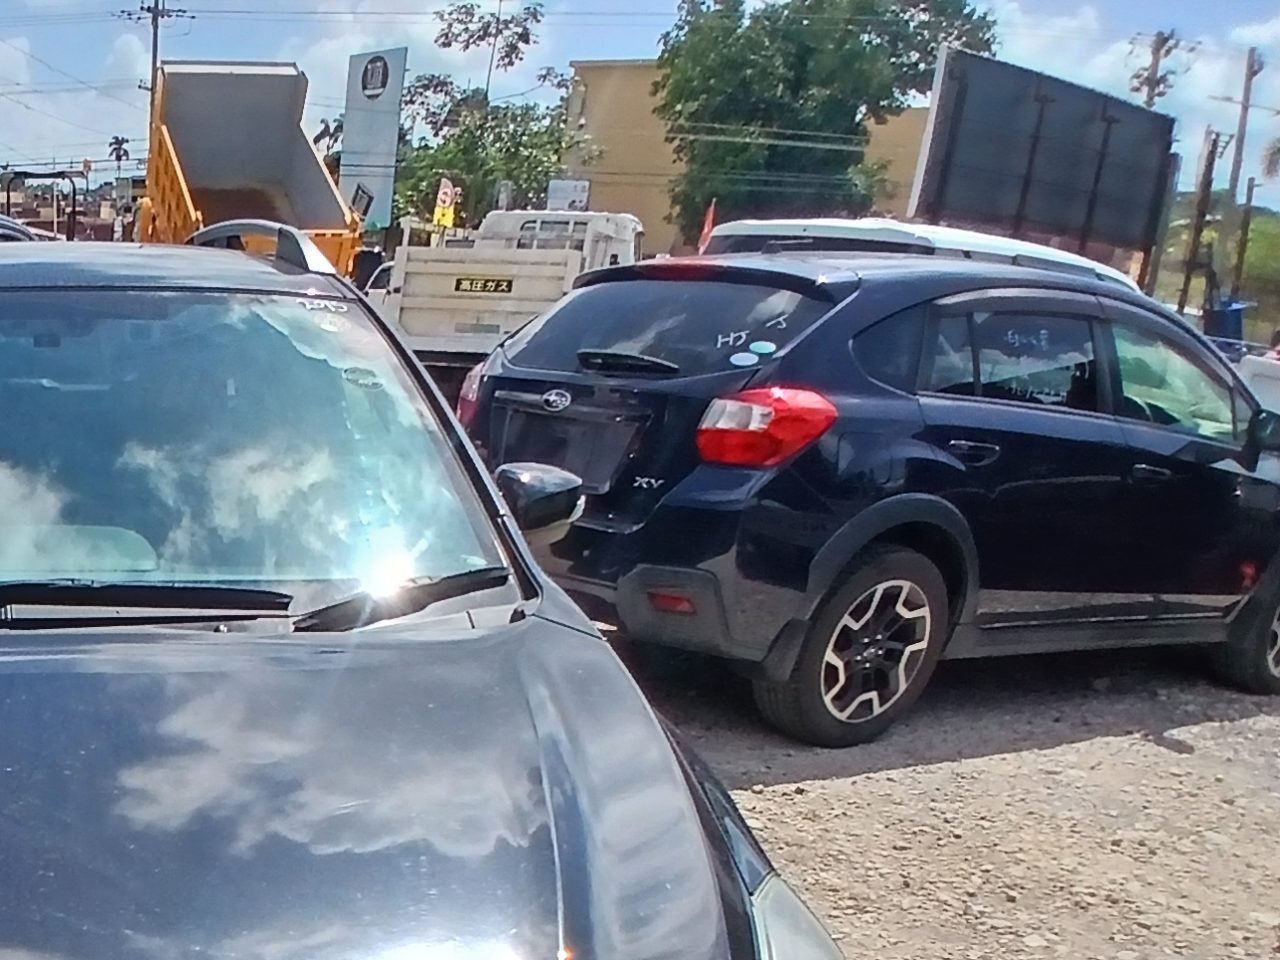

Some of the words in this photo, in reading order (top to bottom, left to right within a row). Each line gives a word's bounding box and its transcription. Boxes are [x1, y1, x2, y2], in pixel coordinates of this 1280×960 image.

[460, 280, 508, 291] 高圧ガス
[633, 476, 664, 488] XV
